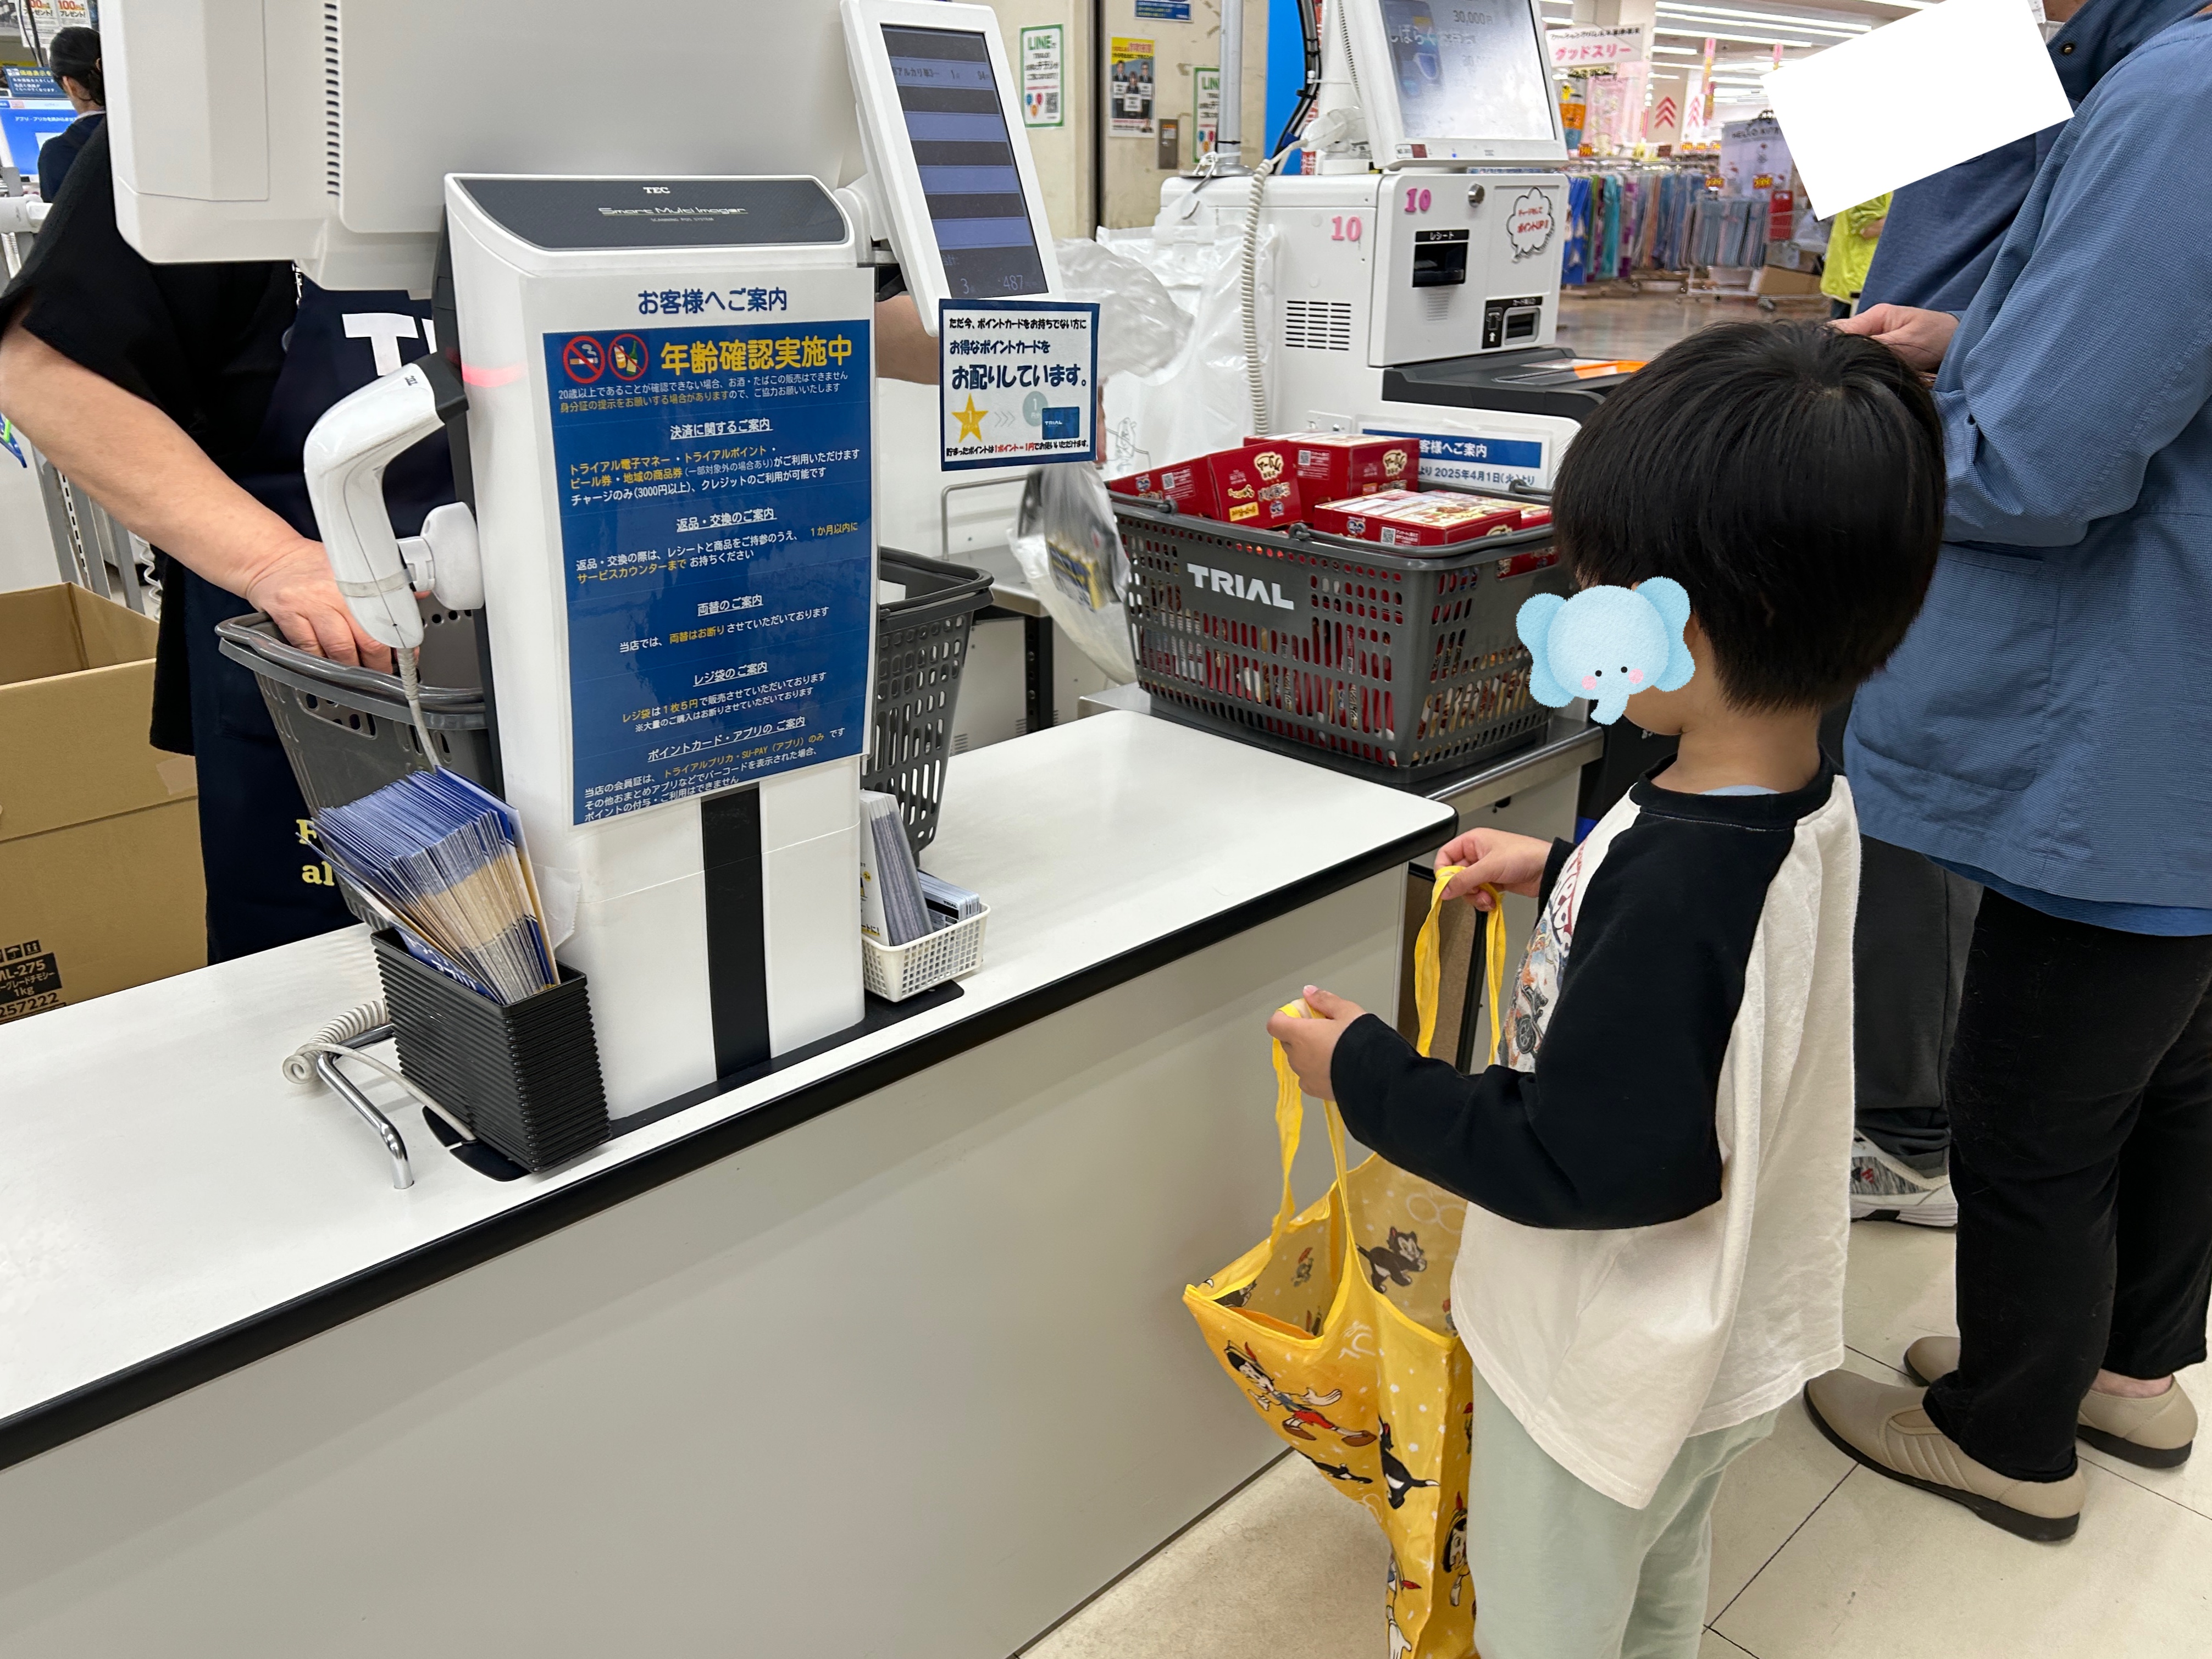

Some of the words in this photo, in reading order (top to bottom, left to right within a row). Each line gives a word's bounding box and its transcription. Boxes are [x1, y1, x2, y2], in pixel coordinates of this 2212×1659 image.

[1405, 188, 1431, 213] 10
[1331, 216, 1362, 241] 10
[1430, 231, 1454, 240] レシート
[638, 287, 788, 314] お客様へご案内
[949, 318, 1086, 330] ただ今、ポイントカードをお持ちでない方に
[661, 334, 852, 375] 年齢確認実施中
[950, 340, 1050, 354] お得なポイントカードを
[952, 364, 1086, 390] お配りしています。
[670, 417, 773, 440] 決済に関するご案内
[677, 507, 777, 532] 返品・交換のご案内
[1187, 563, 1294, 610] TRIAL
[697, 594, 763, 617] 両替のご案内
[693, 662, 768, 687] レジ袋のご案内
[647, 716, 806, 762] ポイントカード・アプリのご案内
[585, 748, 816, 810] その他おまとめアプリなどでバーコードを表示された場合、
[585, 778, 739, 822] ポイントの付与・ご利用はできません
[14, 986, 34, 996] 1kg
